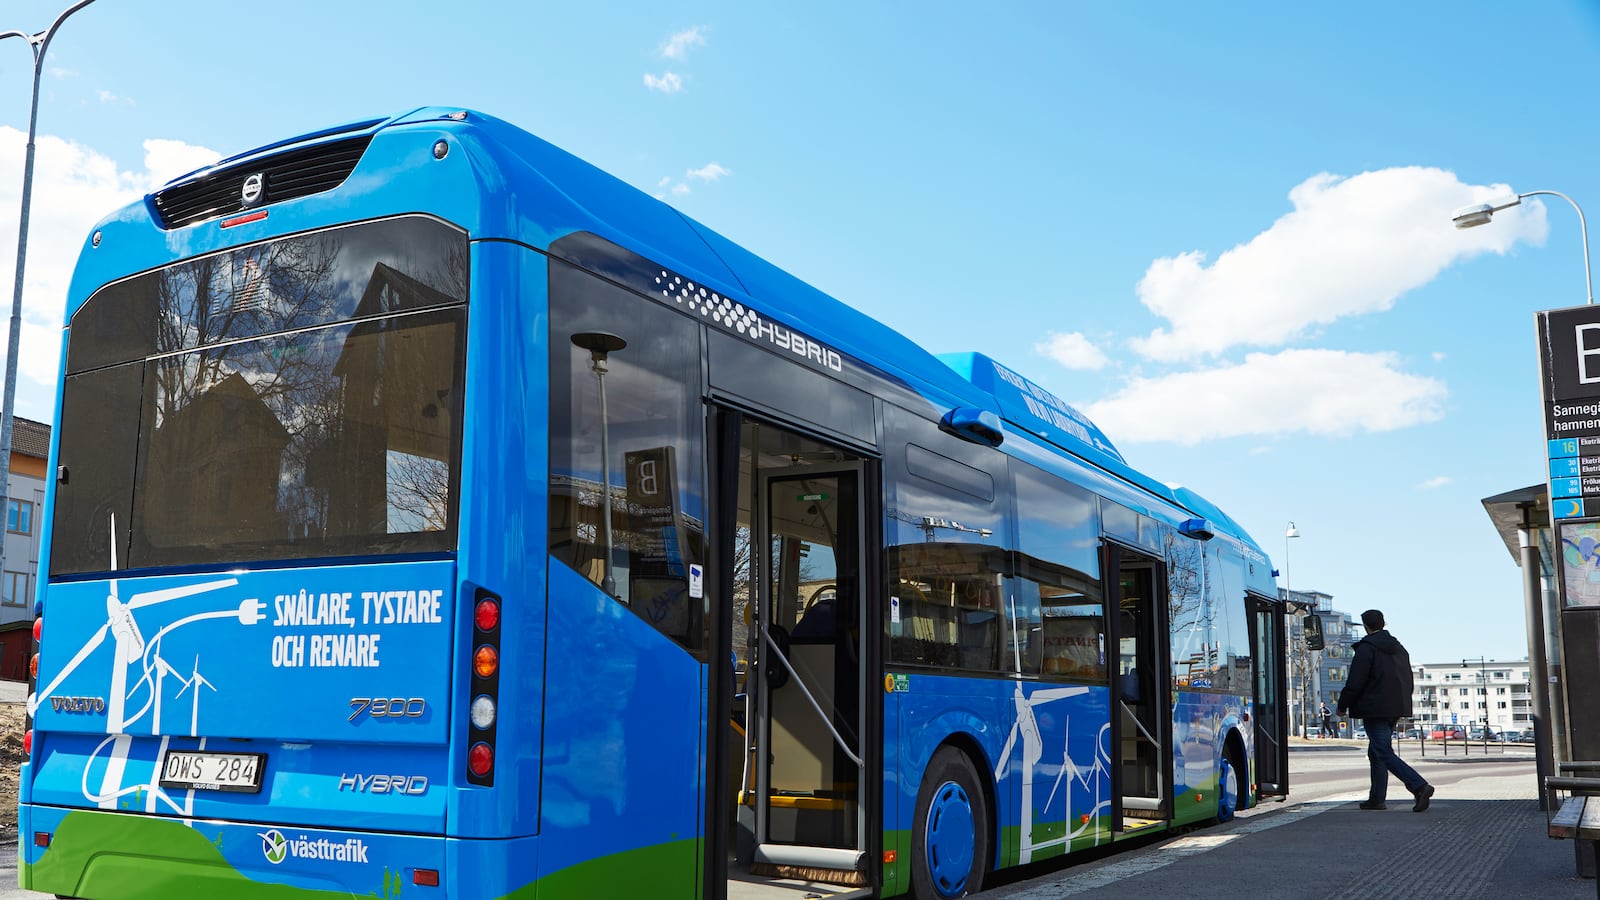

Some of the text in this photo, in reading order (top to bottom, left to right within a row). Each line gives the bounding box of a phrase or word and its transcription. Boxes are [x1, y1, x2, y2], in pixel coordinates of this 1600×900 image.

[757, 318, 842, 372] HYBRID
[1562, 441, 1576, 454] 16
[273, 588, 443, 628] SNÅLARE, TYSTARE
[271, 634, 381, 667] OCH RENARE
[50, 696, 105, 712] VOLVO
[347, 698, 425, 721] 7900
[168, 756, 254, 783] OWS 284
[338, 772, 428, 795] HYBRID
[289, 835, 369, 864] västtrafik
